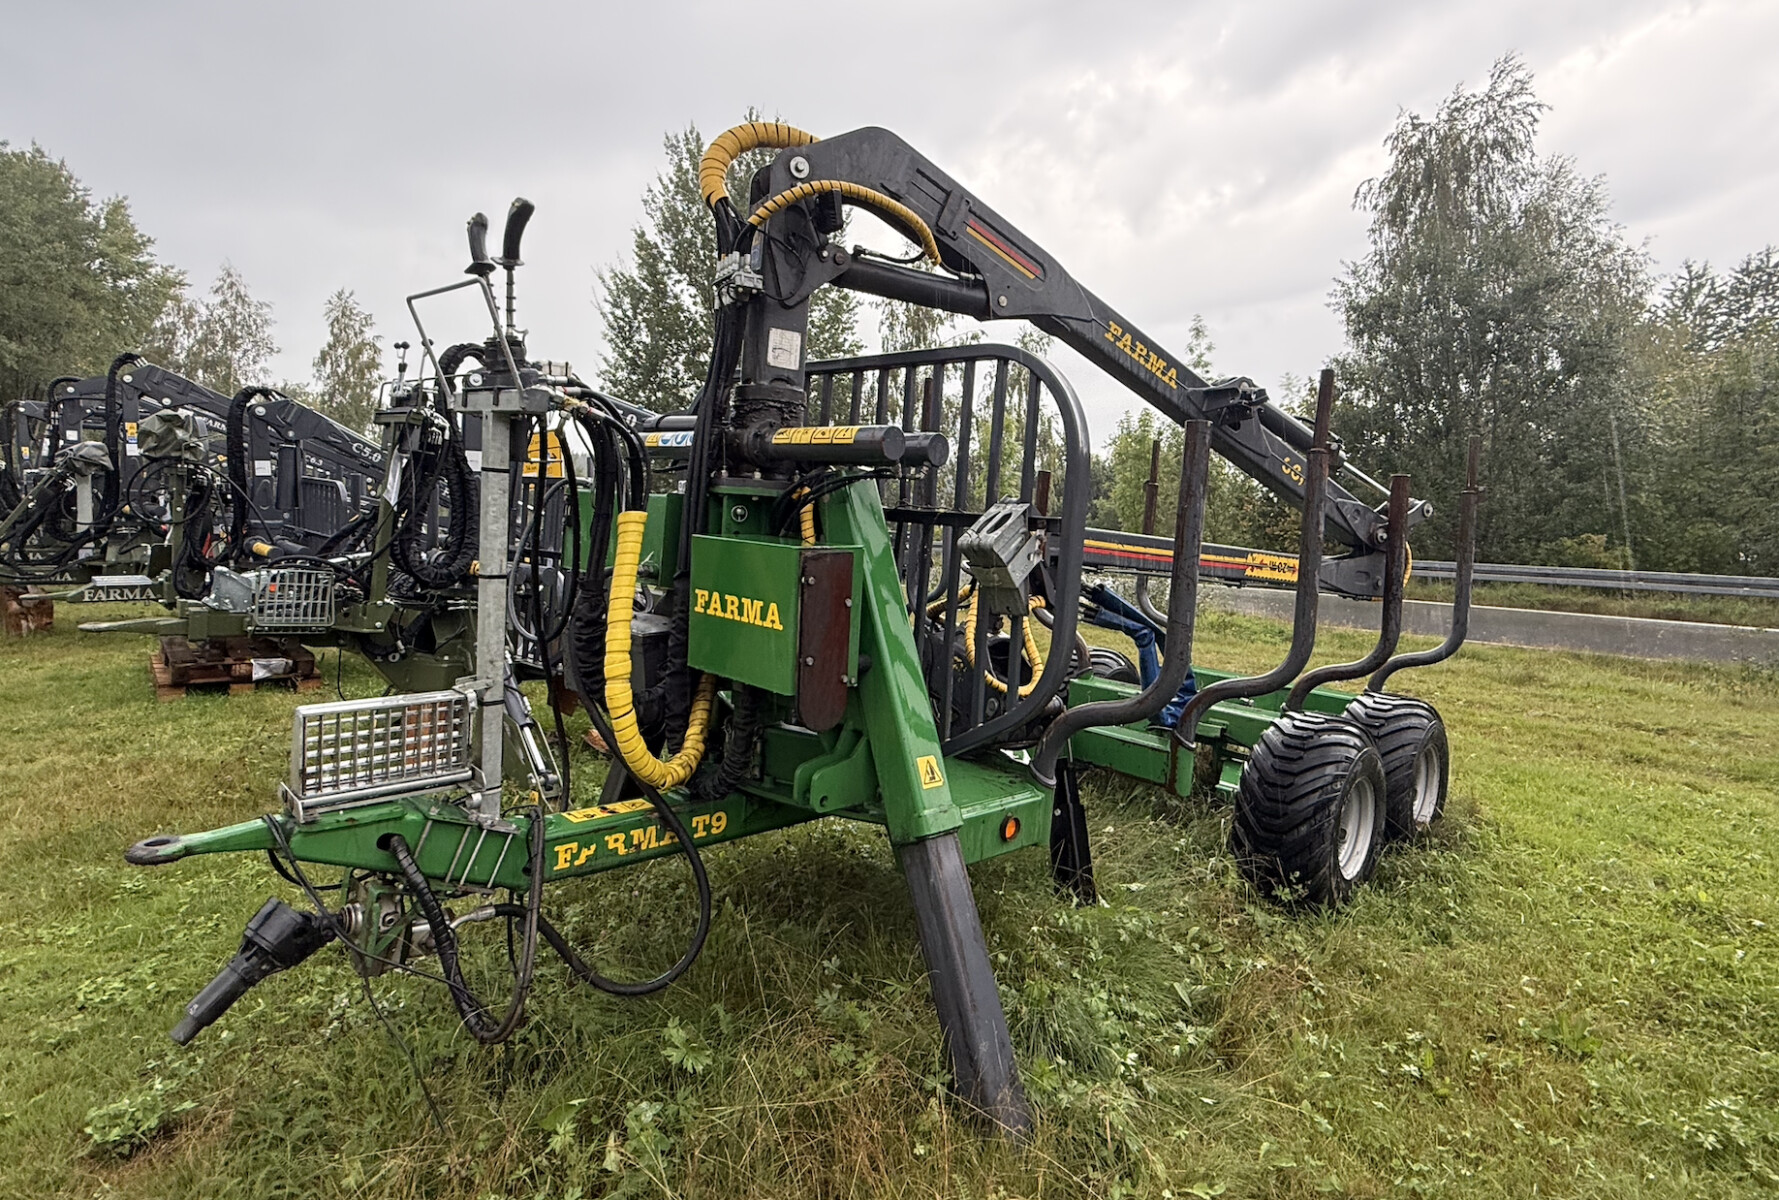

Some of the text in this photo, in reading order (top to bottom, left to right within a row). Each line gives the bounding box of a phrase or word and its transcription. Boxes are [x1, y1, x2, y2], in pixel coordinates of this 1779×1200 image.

[1104, 320, 1178, 390] FARMA
[351, 442, 382, 463] C5.0
[83, 587, 157, 602] FARMA
[694, 588, 784, 631] FARMA
[691, 811, 728, 839] T9
